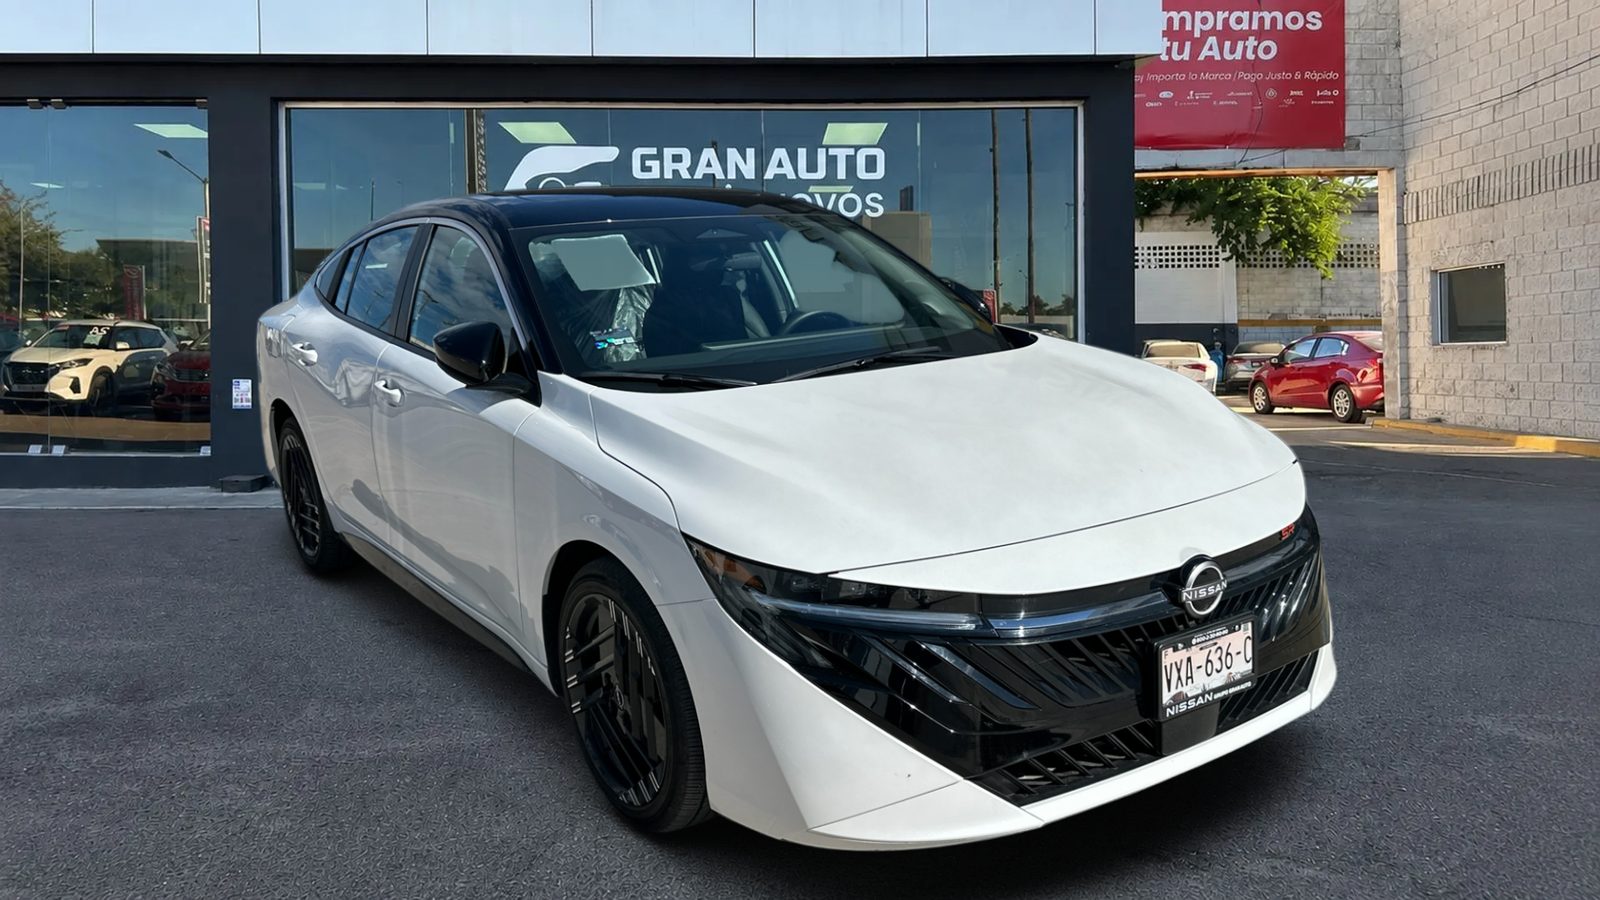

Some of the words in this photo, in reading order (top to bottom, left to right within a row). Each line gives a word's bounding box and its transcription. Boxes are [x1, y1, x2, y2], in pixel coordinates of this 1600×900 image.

[1160, 36, 1191, 61] tu
[1198, 36, 1278, 61] Auto
[1146, 72, 1186, 83] Importa
[1188, 72, 1198, 80] la
[1200, 72, 1232, 80] Marca
[1265, 71, 1292, 80] Justo
[1294, 71, 1302, 80] &
[1304, 70, 1339, 82] Rápido
[631, 146, 756, 180] GRAN
[763, 146, 886, 180] AUTO
[1182, 579, 1228, 601] NISSAN
[1164, 635, 1252, 693] VXA-636-C
[1166, 692, 1213, 718] NISSAN
